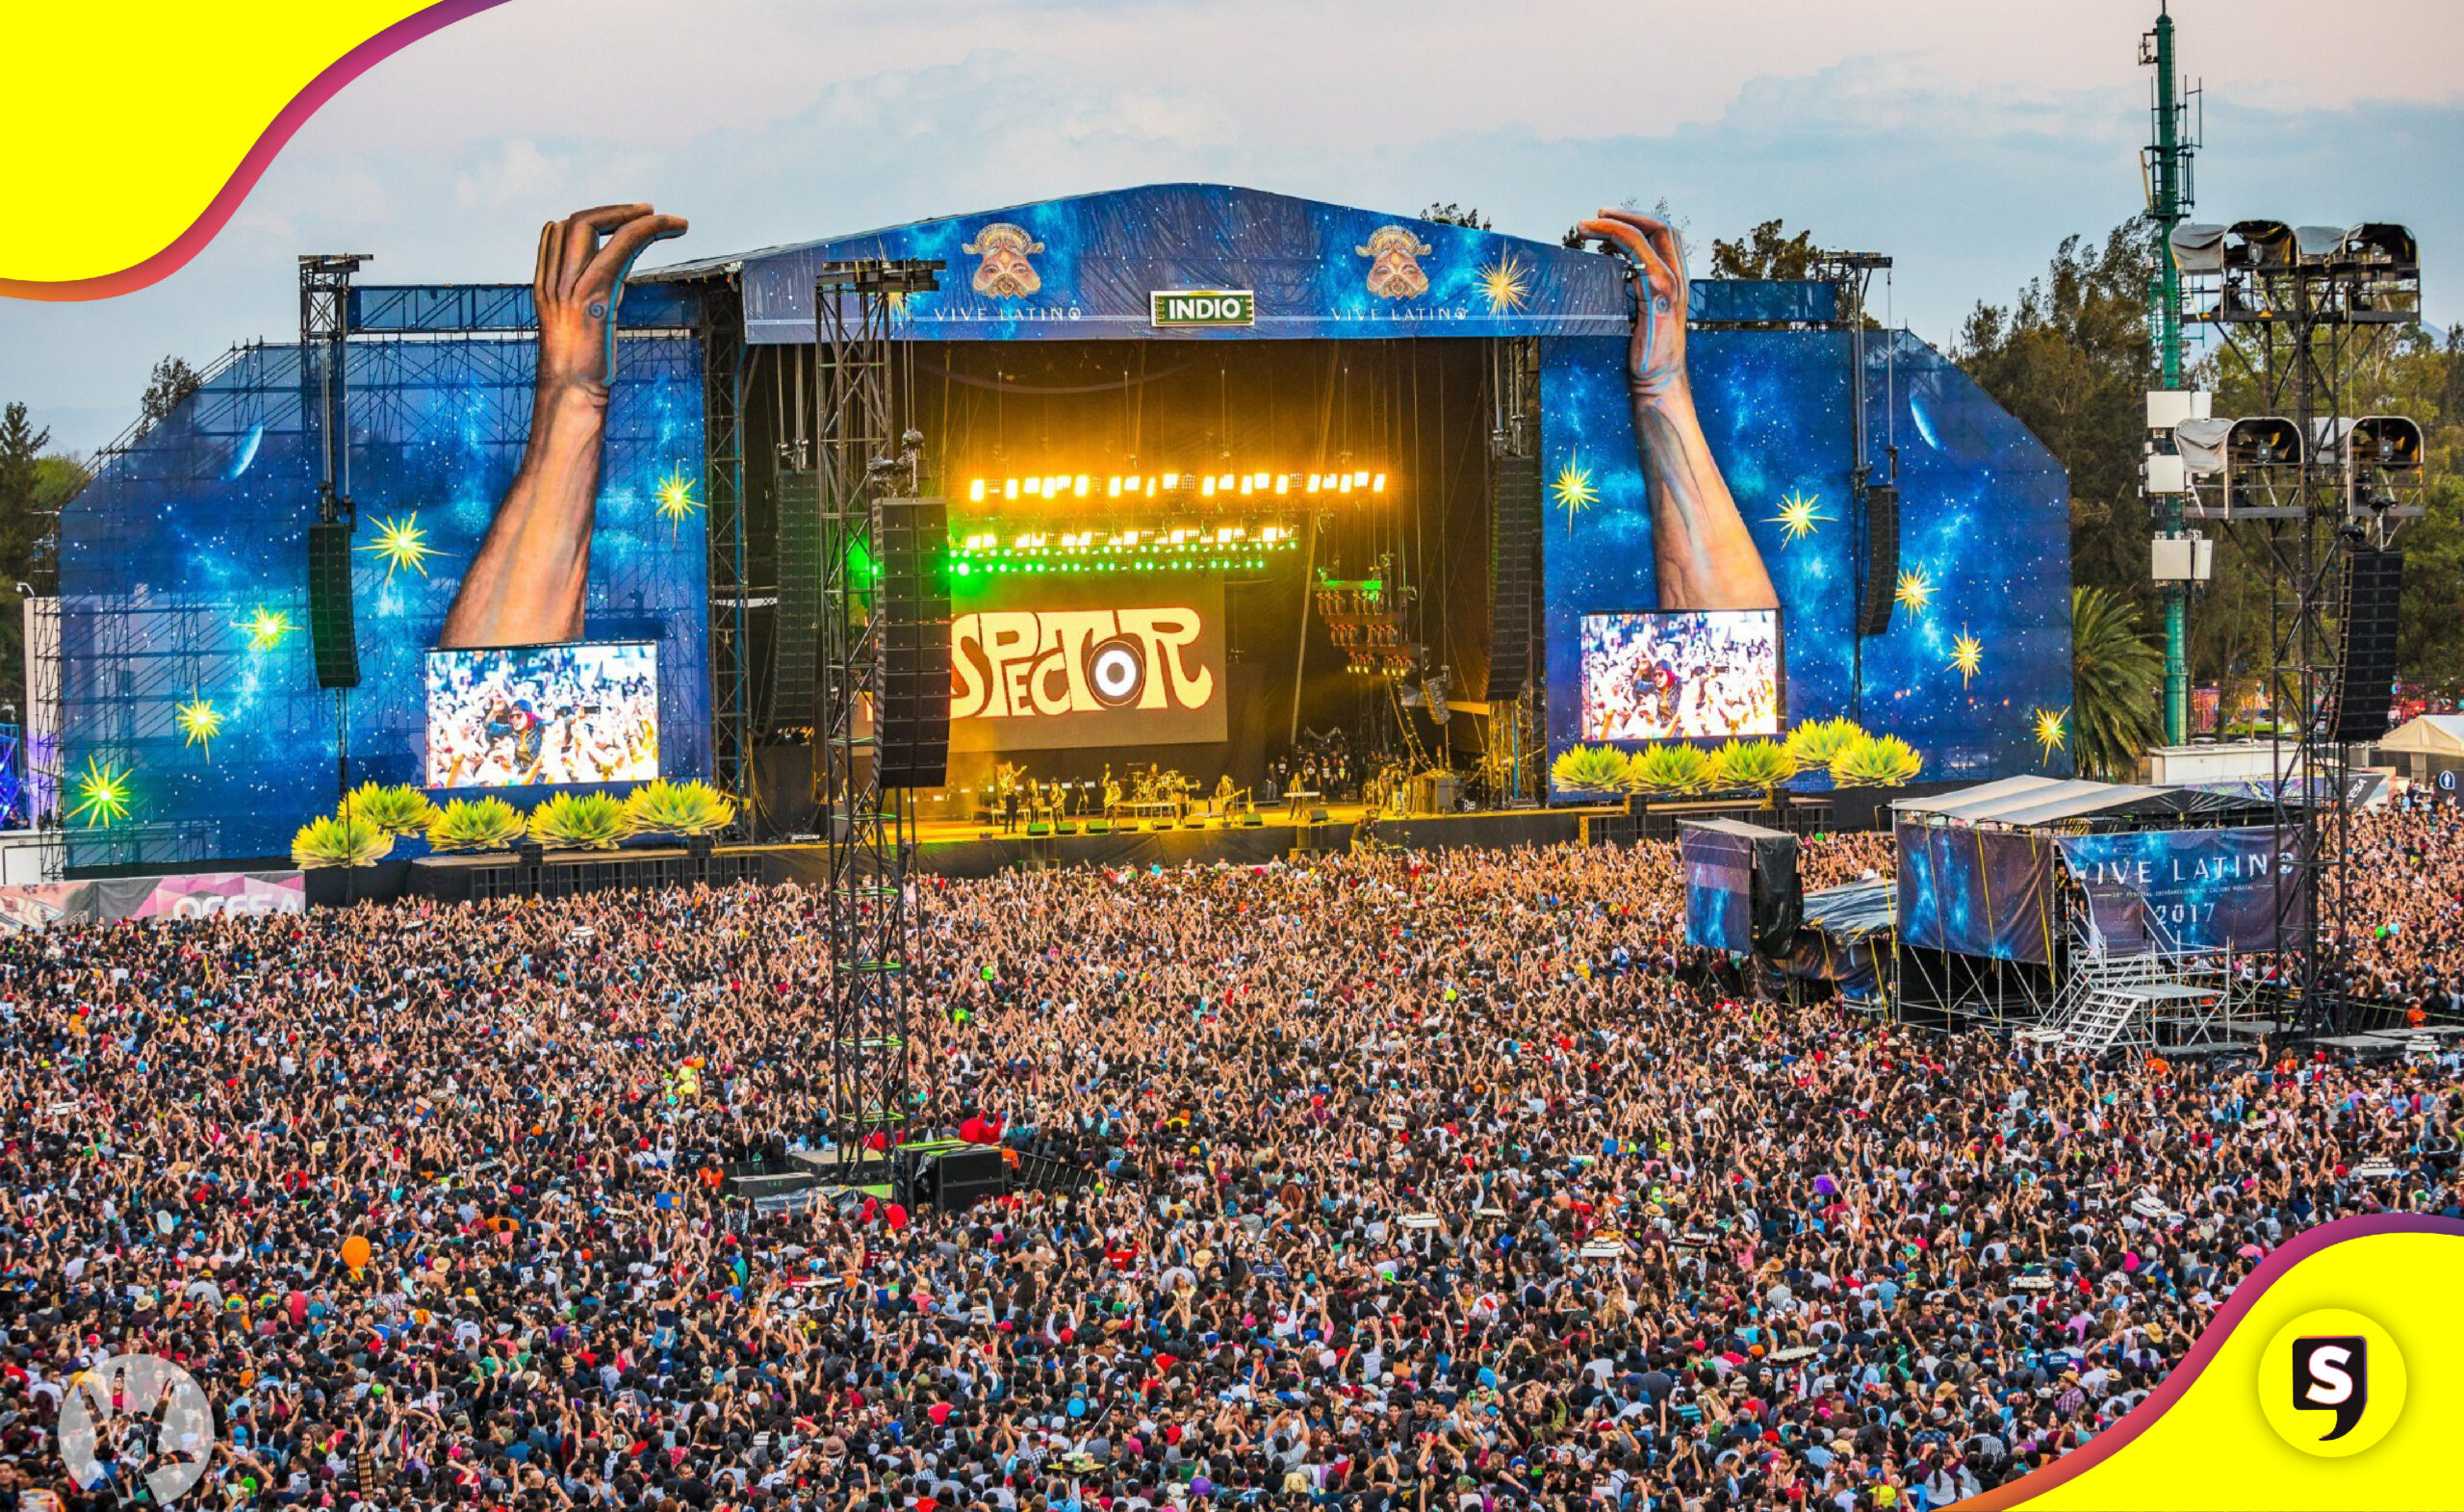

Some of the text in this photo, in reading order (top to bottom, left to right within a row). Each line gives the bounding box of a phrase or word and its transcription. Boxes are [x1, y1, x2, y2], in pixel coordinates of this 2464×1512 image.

[934, 307, 1082, 321] VIVE LATINO
[1168, 297, 1242, 320] INDIO
[1330, 307, 1467, 321] VIVE LATINO
[949, 607, 1214, 719] SPECTOR
[2155, 901, 2215, 926] 2017
